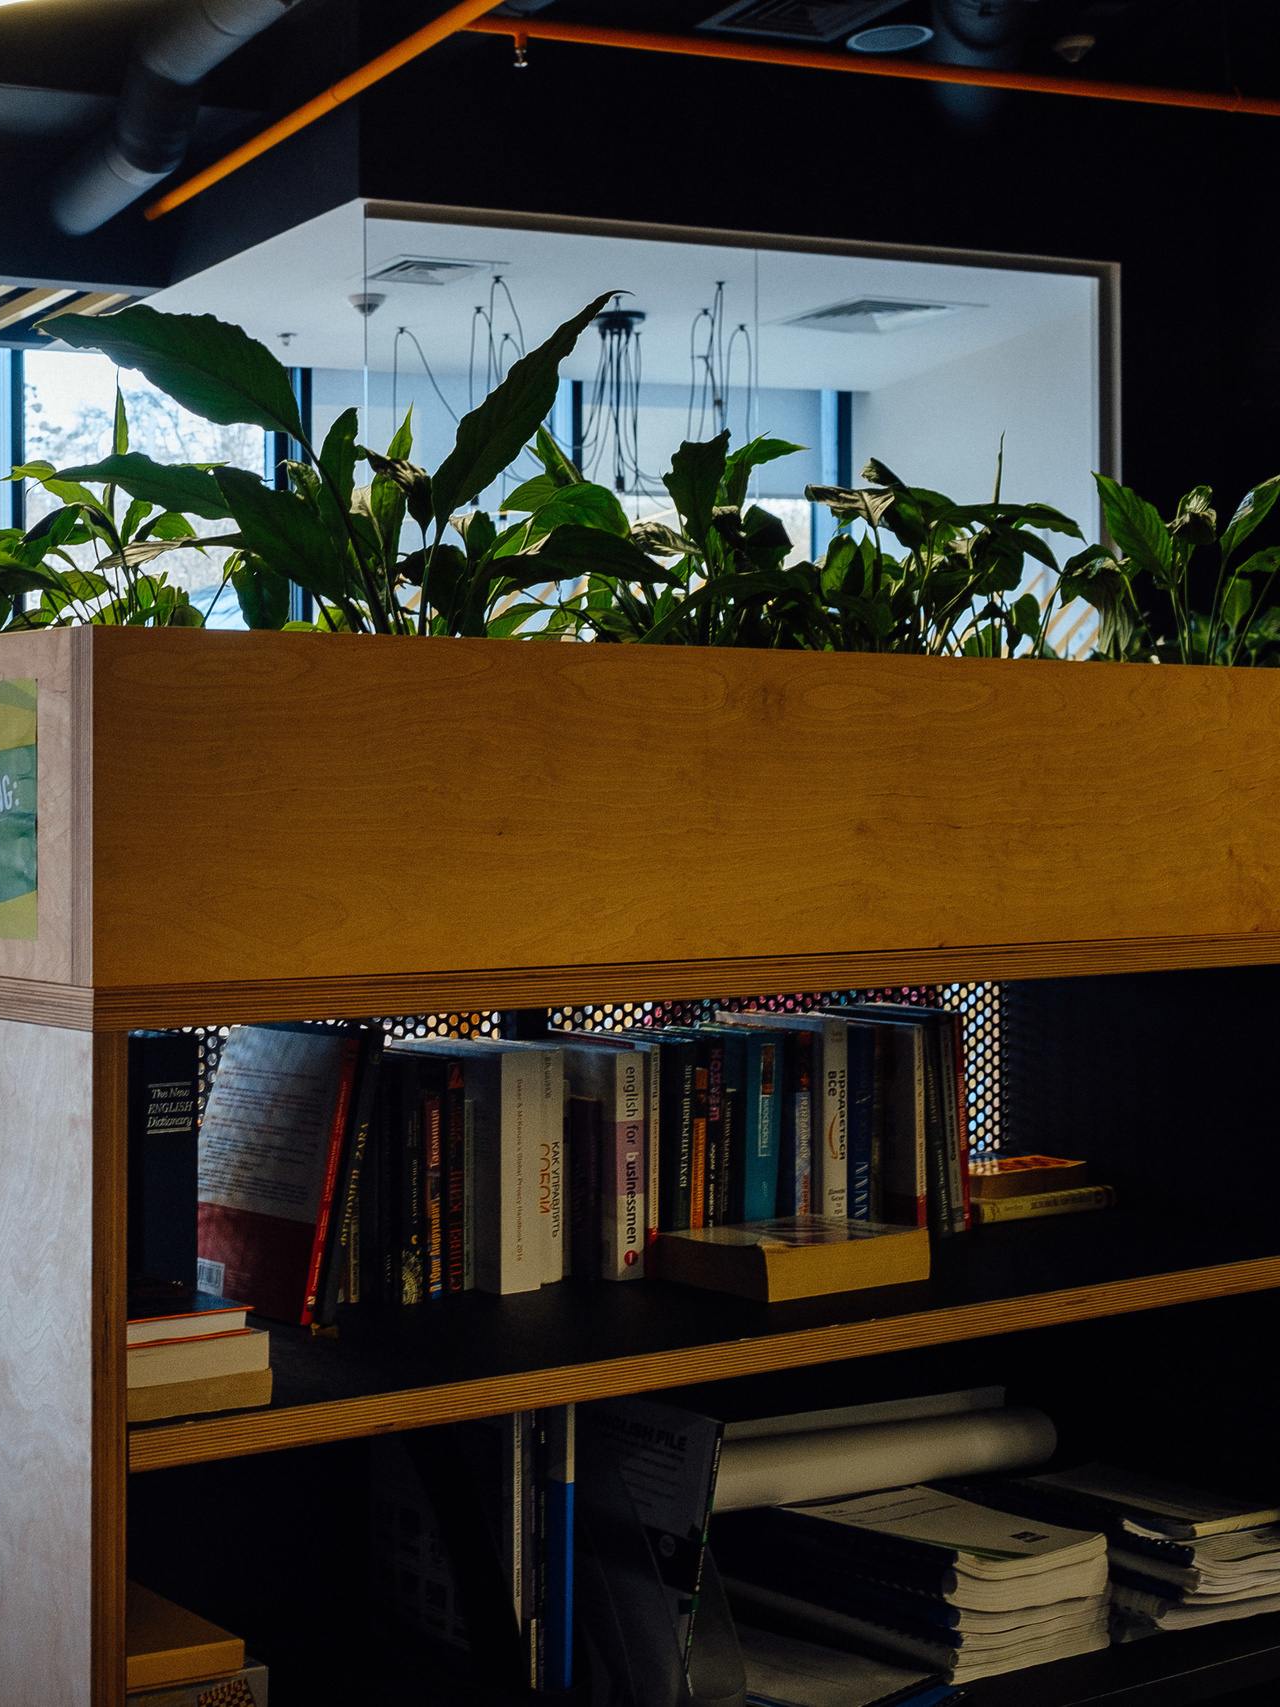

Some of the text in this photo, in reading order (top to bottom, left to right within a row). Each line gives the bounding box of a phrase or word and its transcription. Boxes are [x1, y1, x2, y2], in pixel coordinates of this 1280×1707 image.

[151, 1087, 190, 1099] The New
[828, 1070, 837, 1097] все
[146, 1116, 193, 1128] Dictionary
[147, 1101, 193, 1114] ENGLISH
[355, 1122, 369, 1161] ZARA
[429, 1108, 440, 1168] Таємниця
[623, 1067, 639, 1244] english for businessmen
[551, 1141, 560, 1238] КАК УПРАВЛЯТЬ
[592, 1410, 688, 1452] ENGLISH FILE
